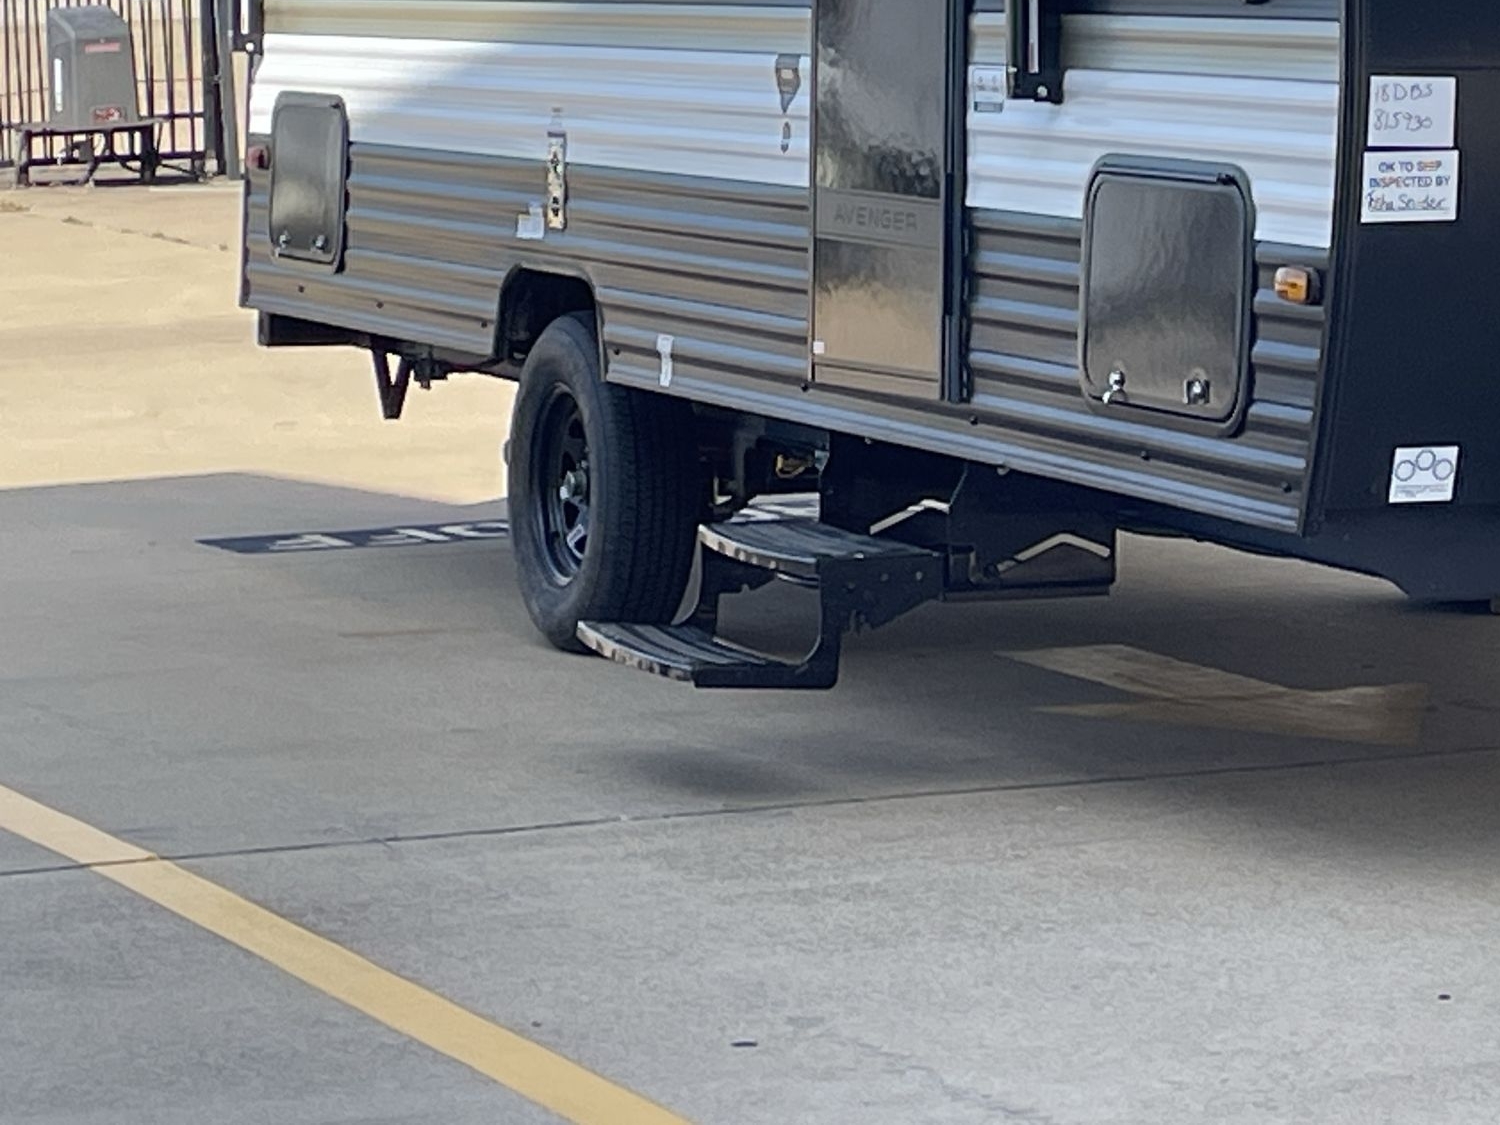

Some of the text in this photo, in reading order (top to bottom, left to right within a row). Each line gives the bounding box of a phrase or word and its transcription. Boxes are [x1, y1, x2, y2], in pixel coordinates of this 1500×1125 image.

[1378, 161, 1396, 173] OK
[1398, 160, 1414, 173] TO
[1435, 175, 1451, 187] BY
[833, 203, 919, 230] AVENGER
